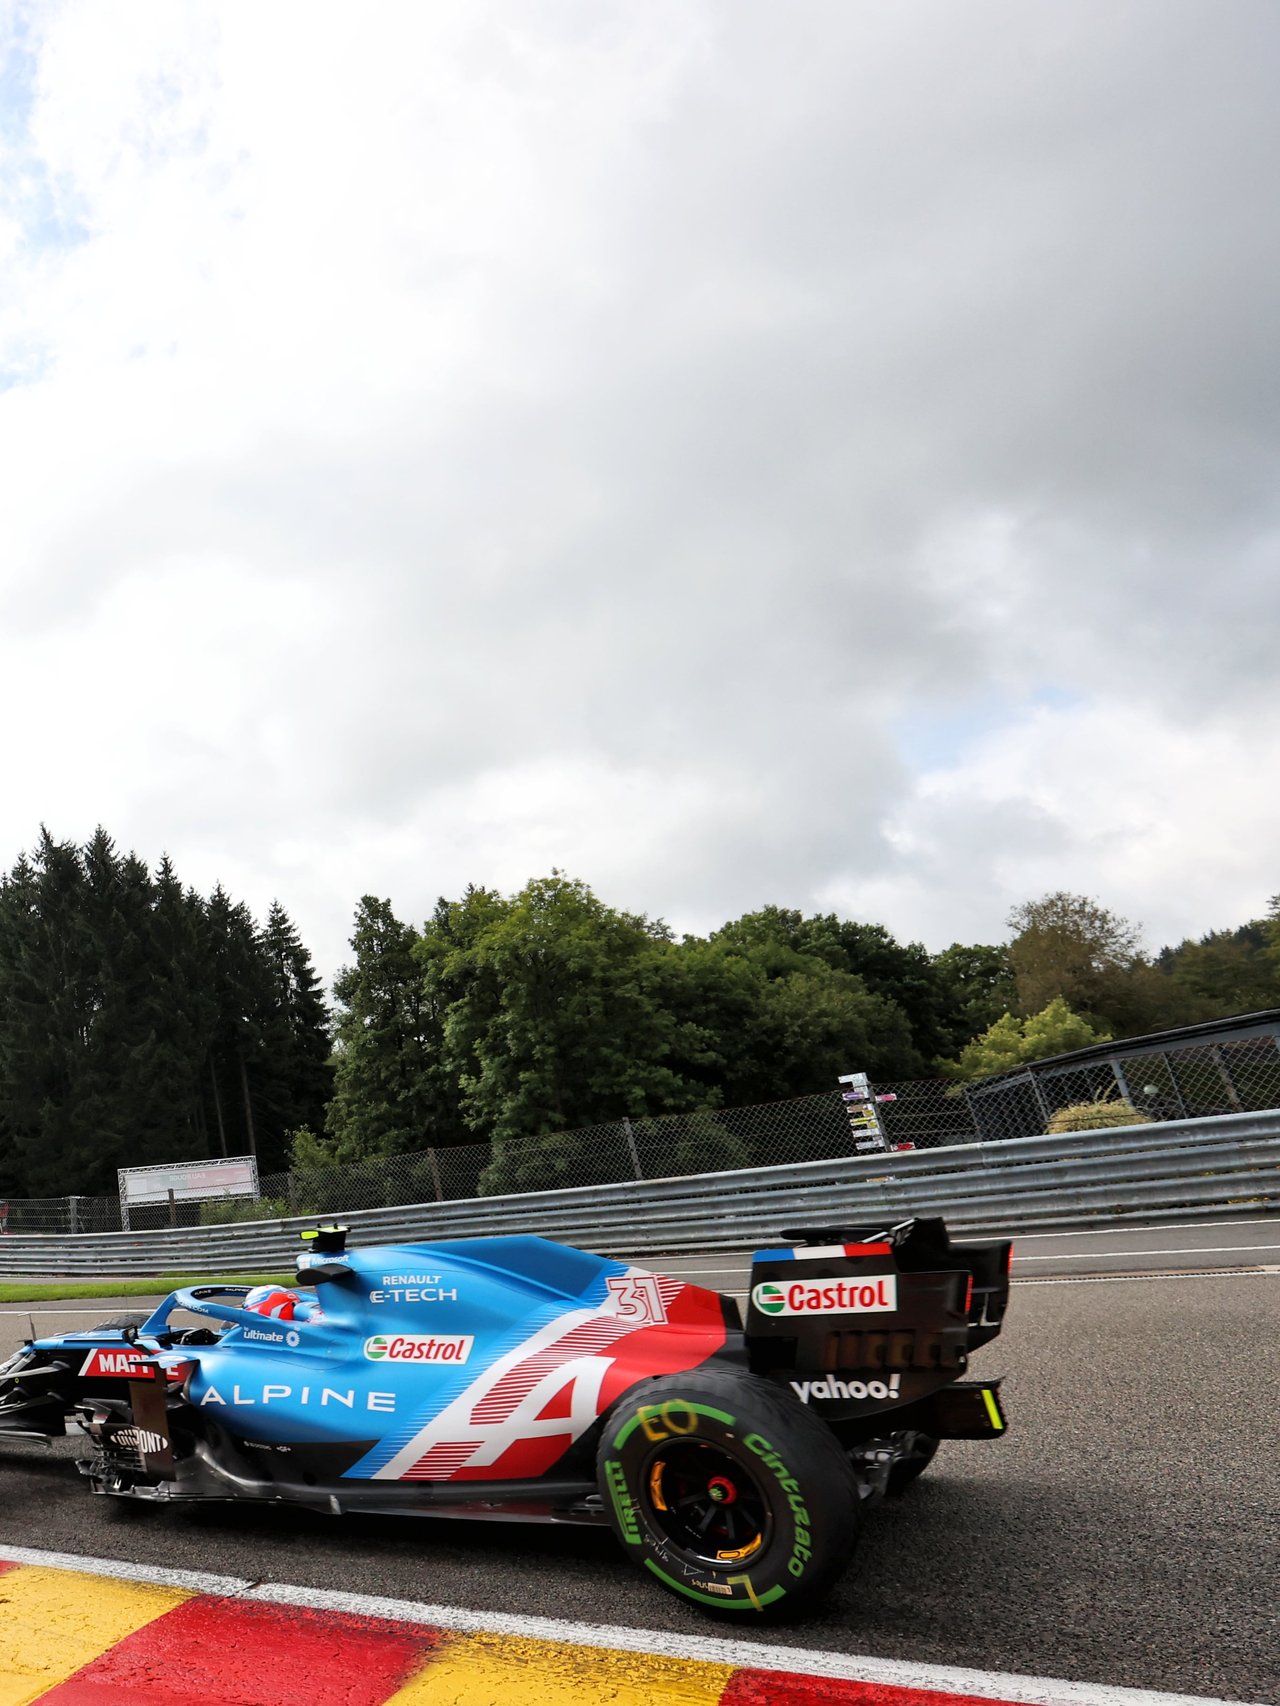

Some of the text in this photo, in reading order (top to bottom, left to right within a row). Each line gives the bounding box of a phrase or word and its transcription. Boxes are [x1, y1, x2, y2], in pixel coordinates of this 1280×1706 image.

[311, 1254, 349, 1266] Microsoft
[382, 1275, 441, 1286] RENAULT
[370, 1288, 458, 1304] E-TECH
[607, 1275, 668, 1326] 31
[787, 1280, 888, 1311] Castrol
[243, 1328, 284, 1344] ultimate
[389, 1337, 464, 1362] Castrol
[200, 1384, 397, 1413] ALPINE
[789, 1373, 902, 1404] yahoo!
